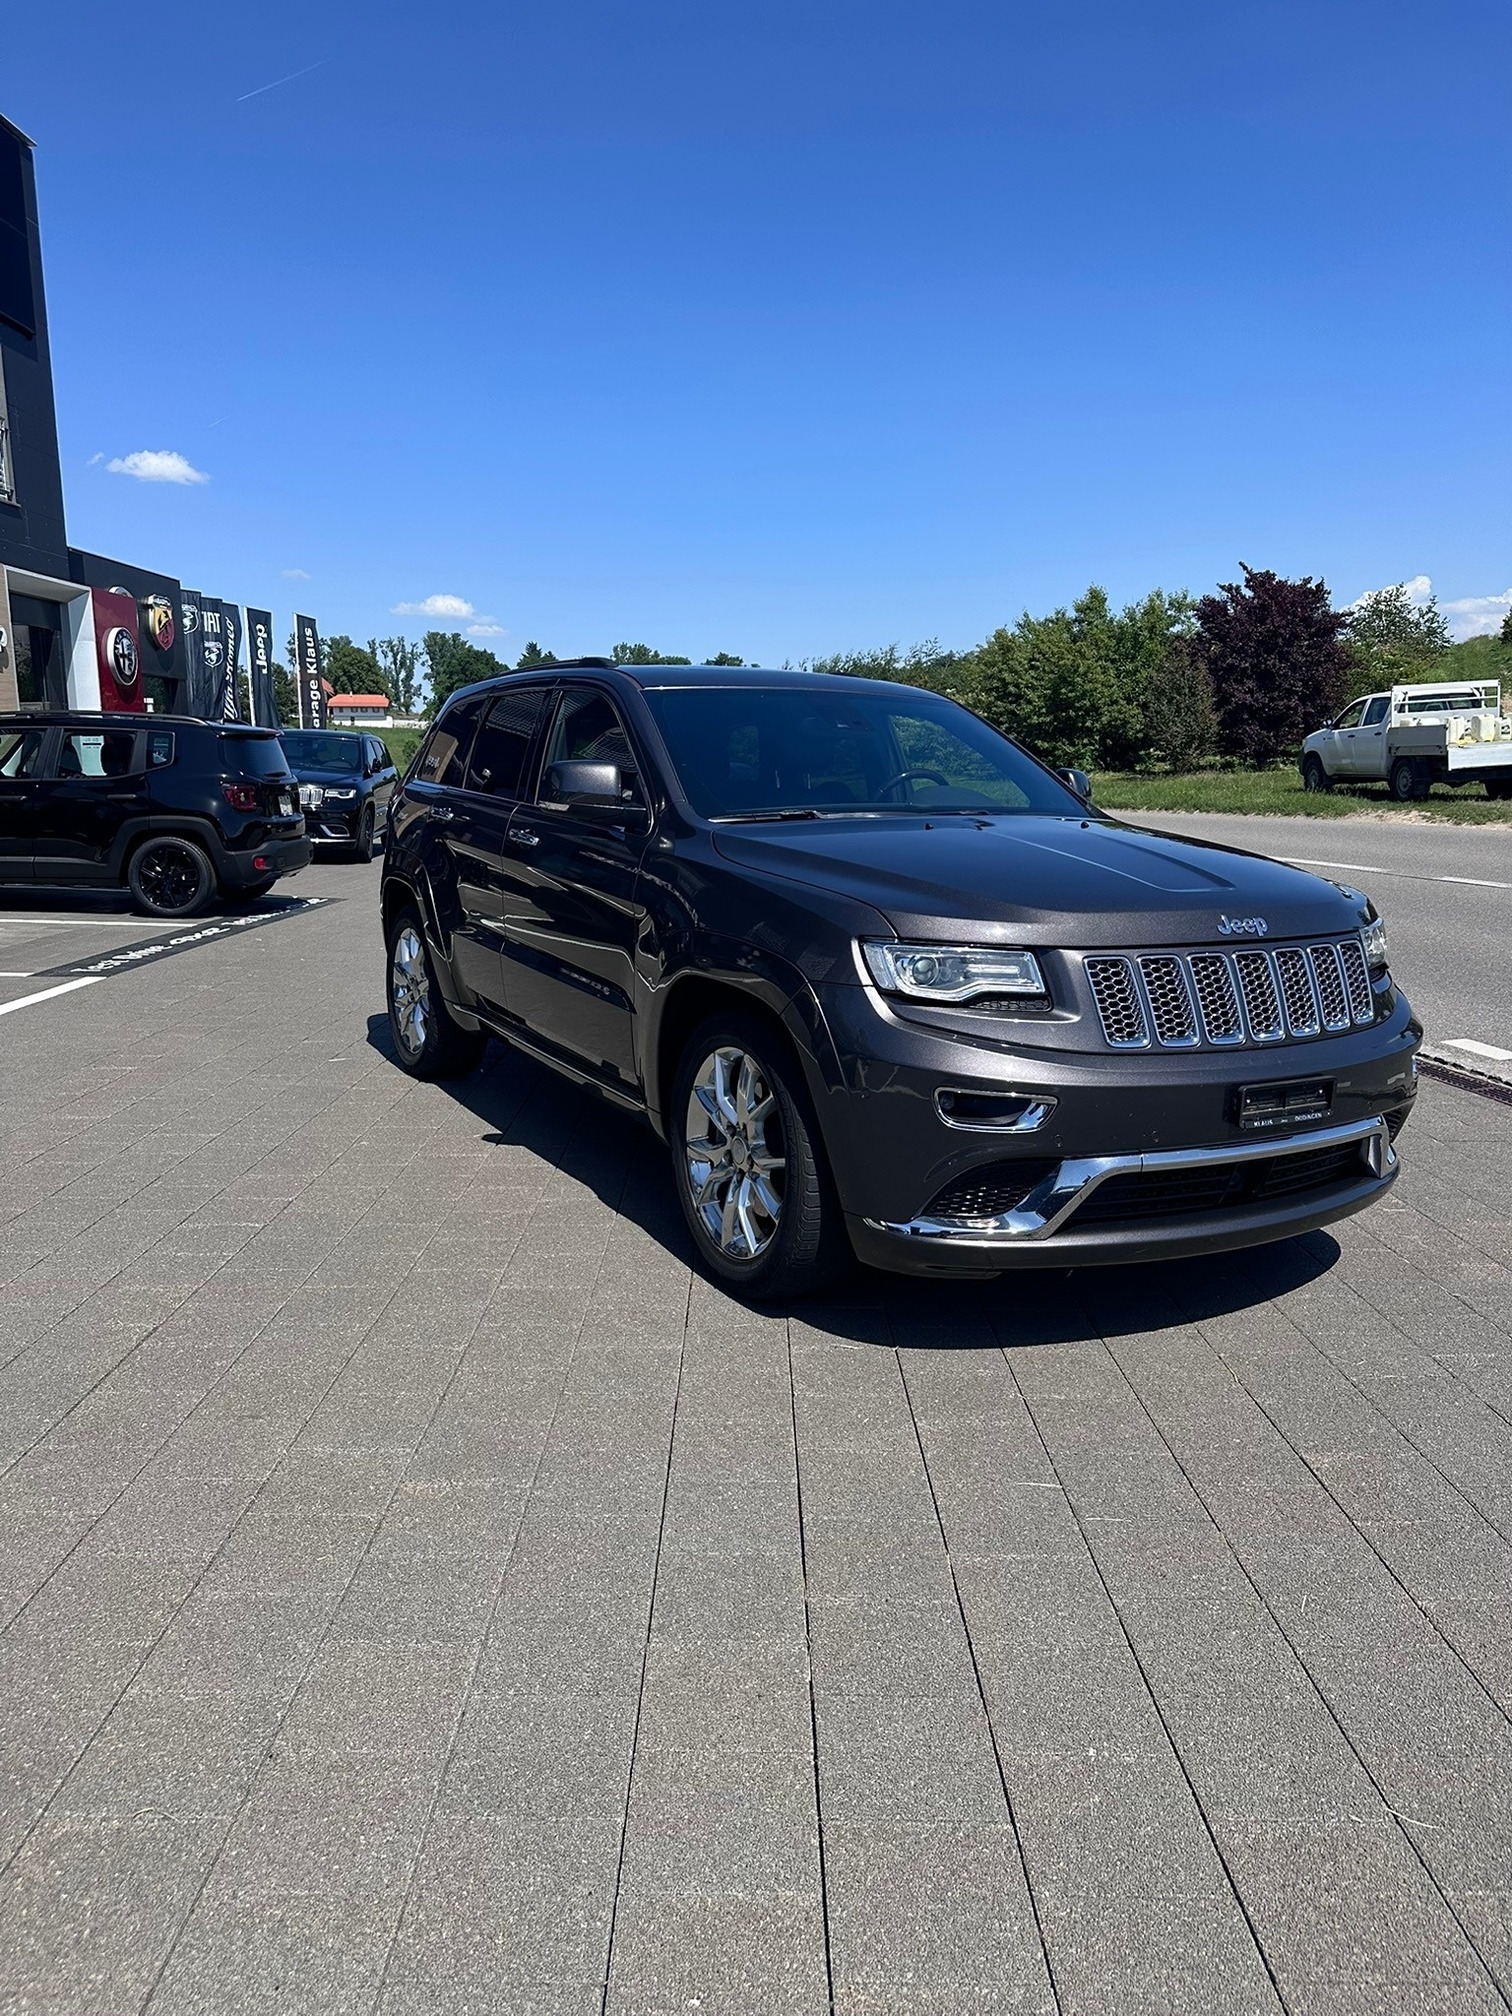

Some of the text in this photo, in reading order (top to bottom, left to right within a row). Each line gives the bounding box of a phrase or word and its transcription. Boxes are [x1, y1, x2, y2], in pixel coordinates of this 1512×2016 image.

[202, 611, 220, 633] IAT
[256, 624, 268, 675] Jeep
[304, 627, 321, 728] arage Klaus
[1217, 914, 1268, 937] Jeep
